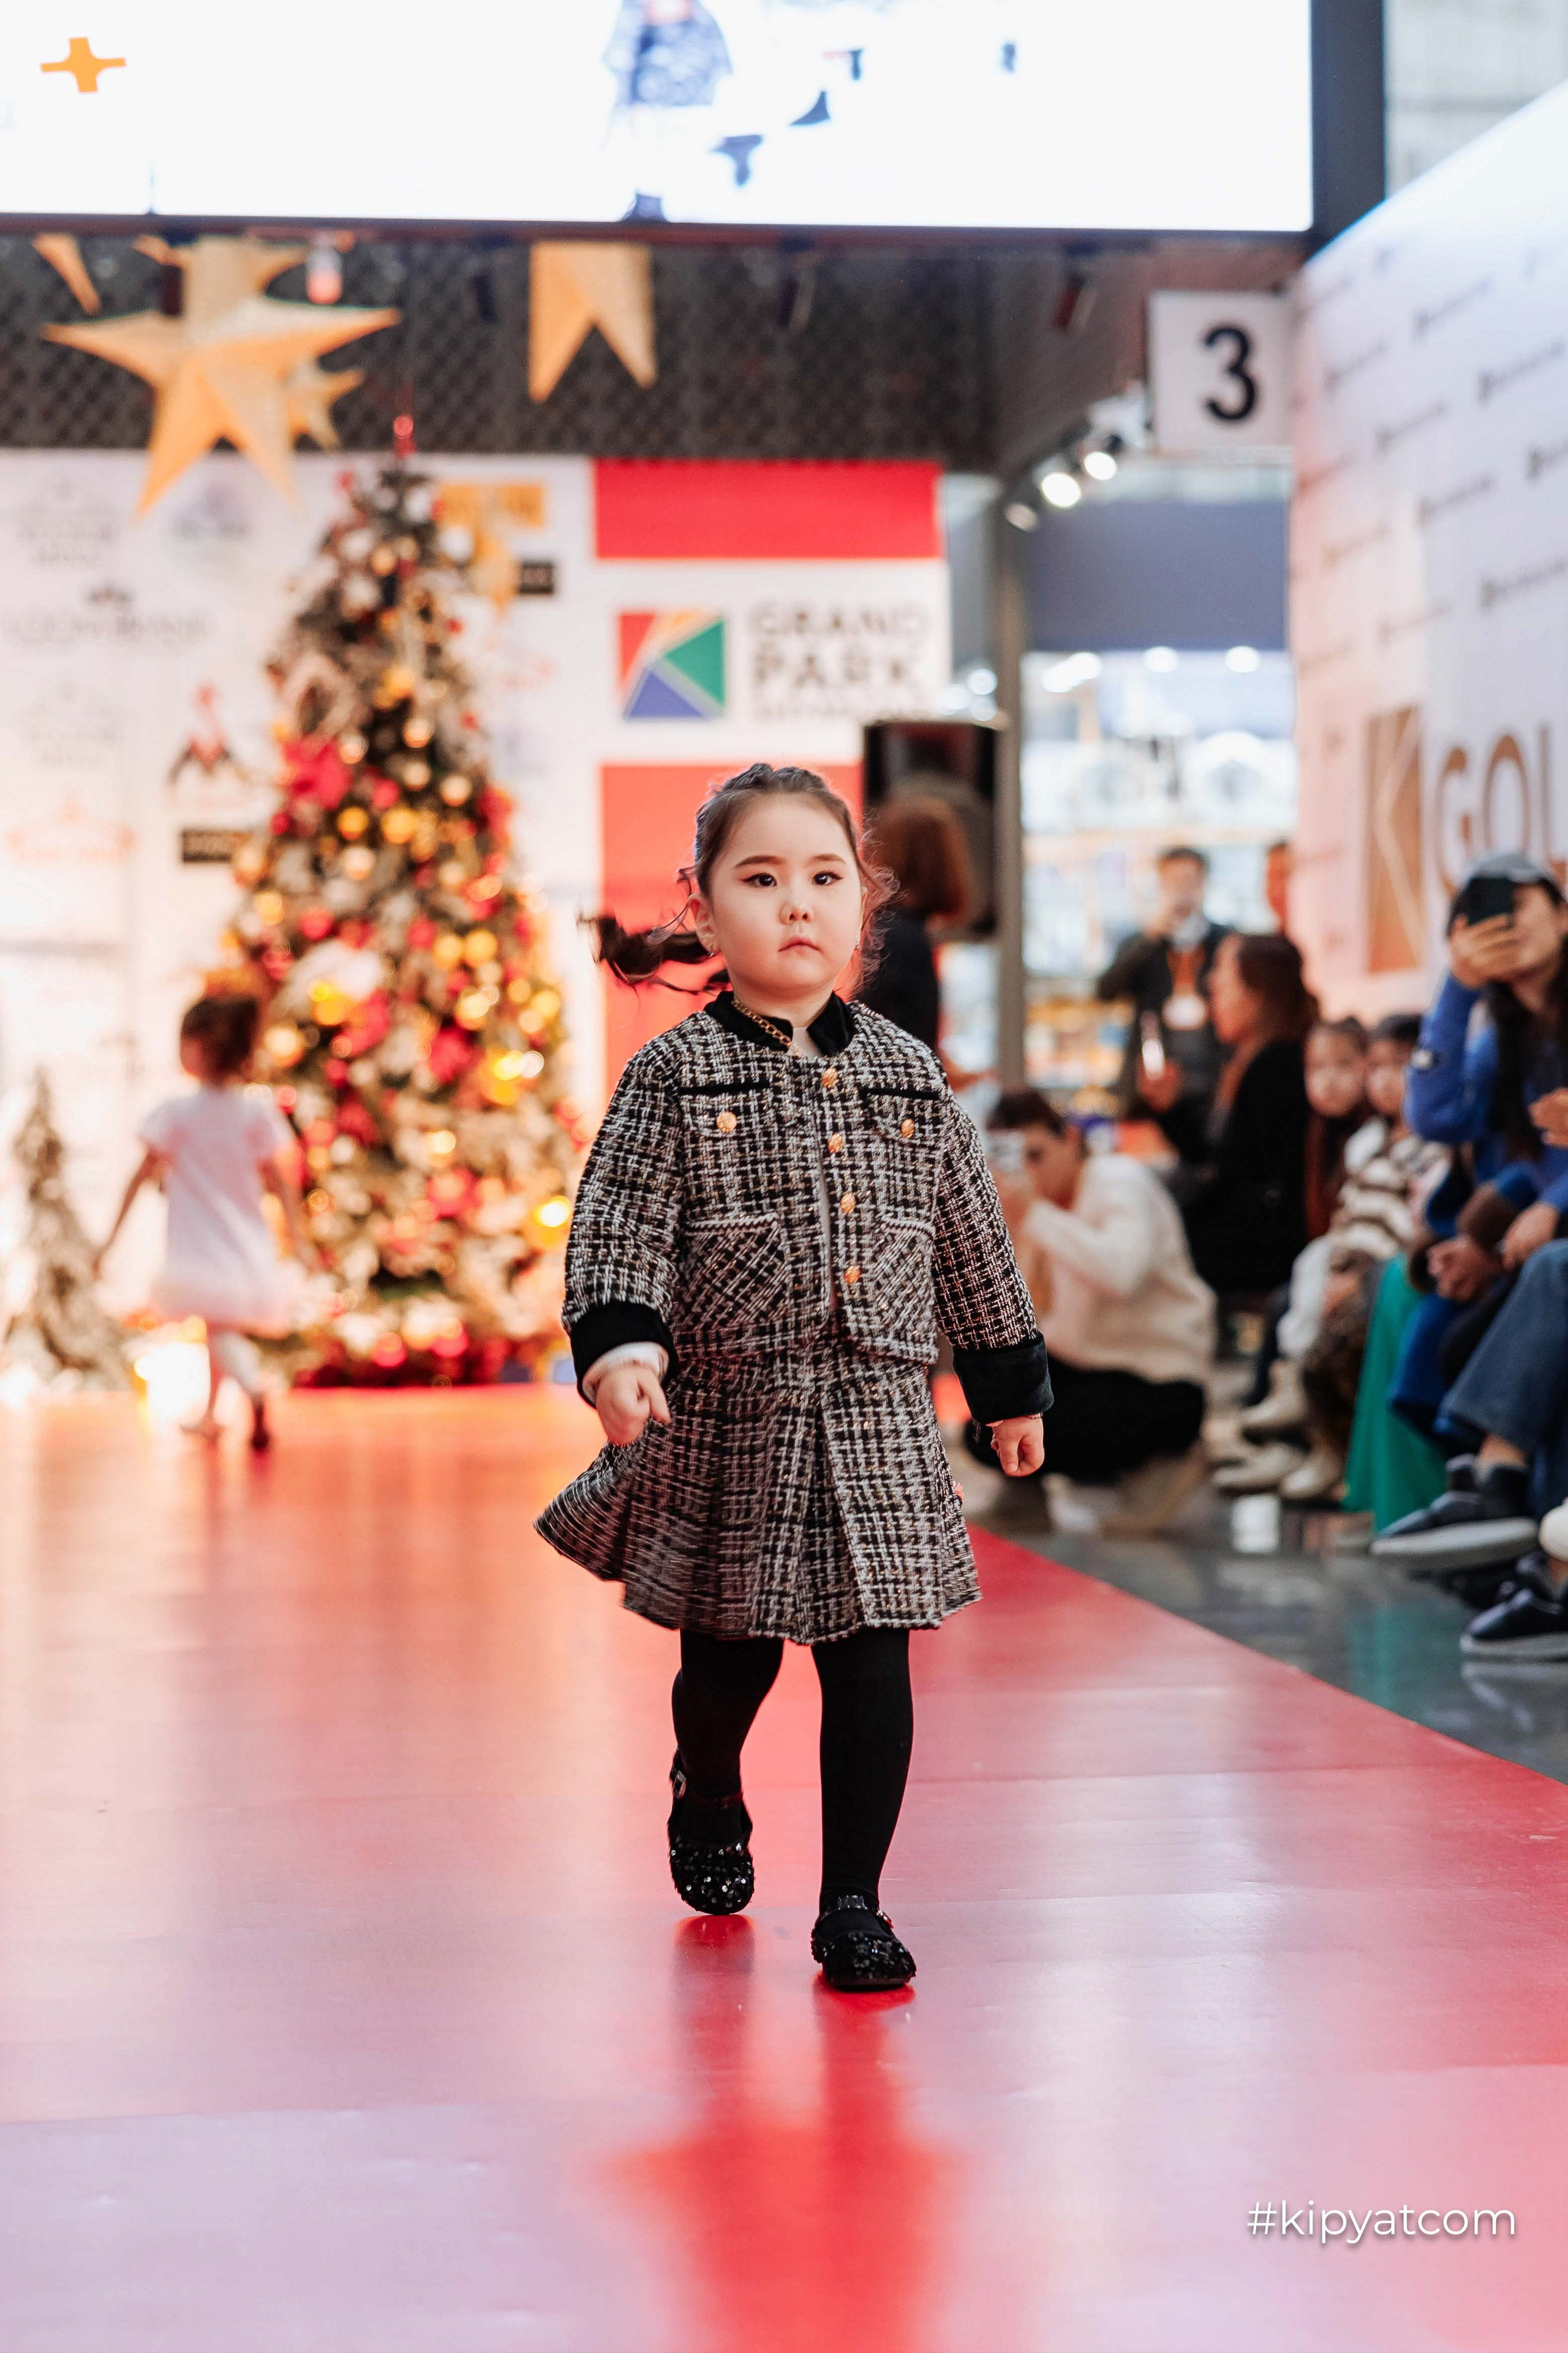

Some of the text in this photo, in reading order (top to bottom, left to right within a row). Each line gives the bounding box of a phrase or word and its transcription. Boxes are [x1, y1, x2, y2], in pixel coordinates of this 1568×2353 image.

[1202, 325, 1258, 424] 3
[748, 601, 927, 637] GRAND
[752, 646, 921, 689] PARK
